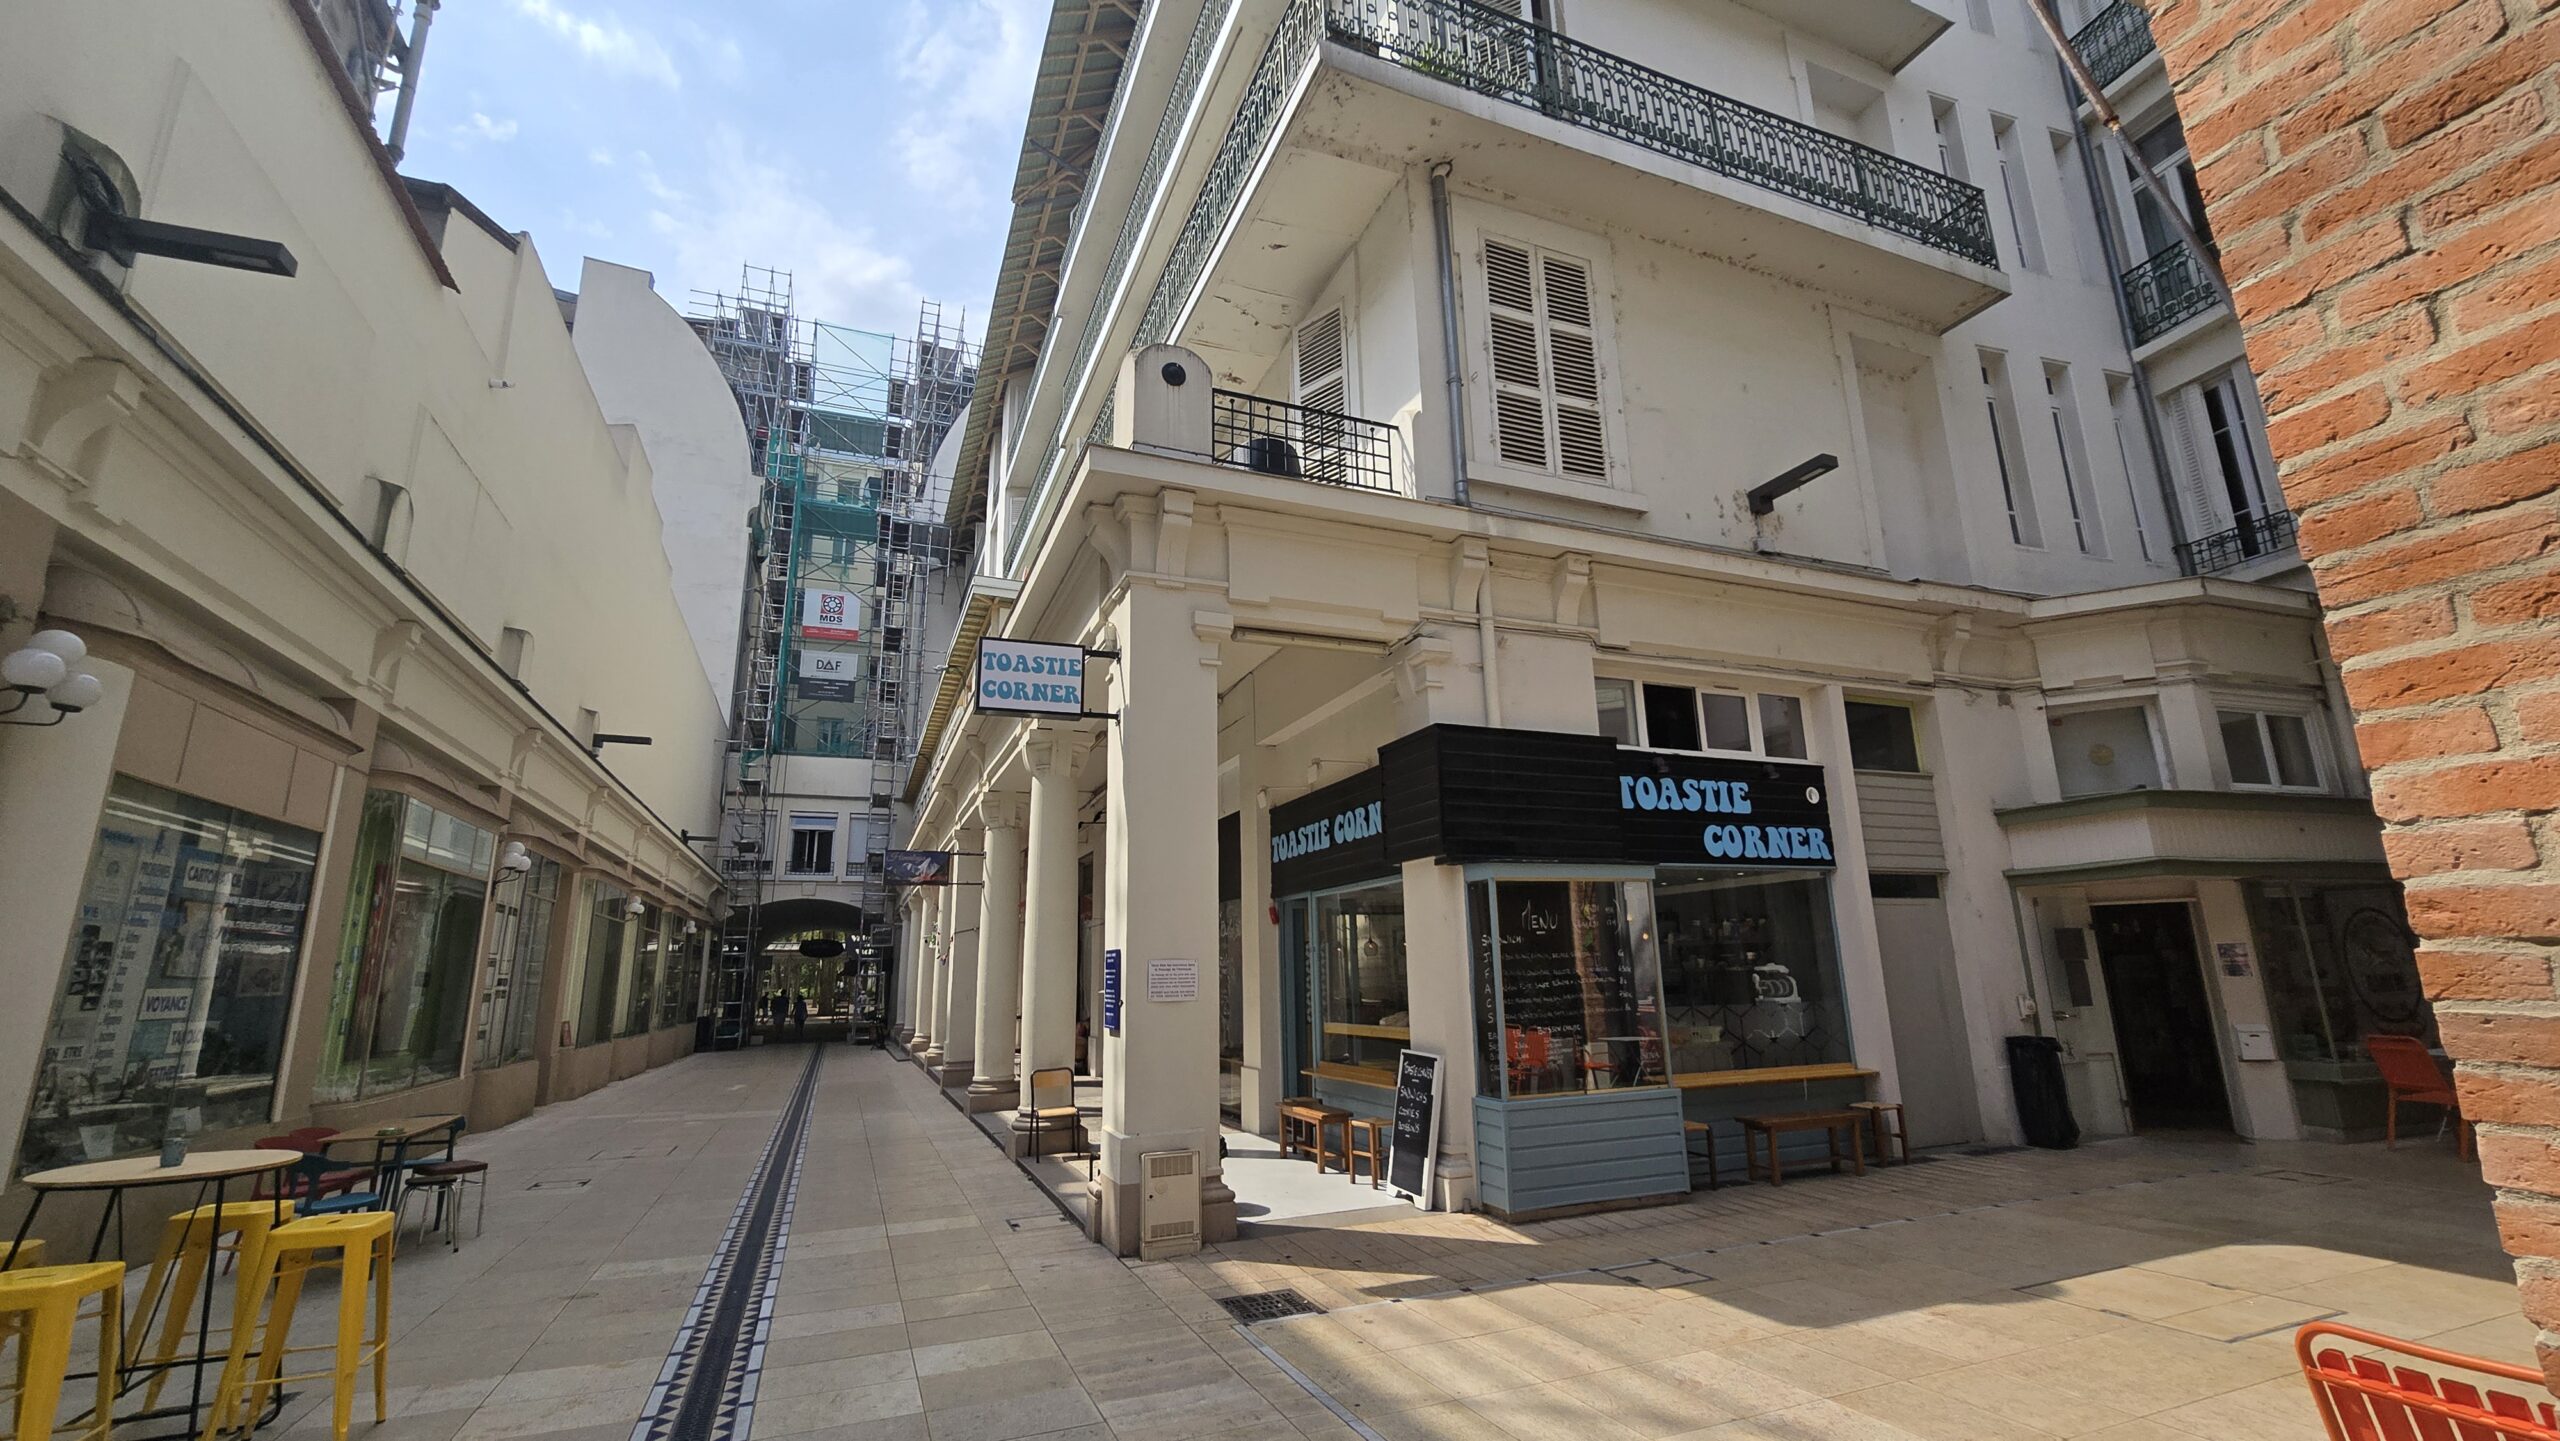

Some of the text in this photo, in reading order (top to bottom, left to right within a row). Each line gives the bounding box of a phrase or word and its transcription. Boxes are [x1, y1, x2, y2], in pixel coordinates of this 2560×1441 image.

[819, 614, 843, 624] MDS
[983, 652, 1081, 677] TOASTIE
[982, 680, 1080, 704] CORNER
[1620, 776, 1752, 814] TOASTIE
[1272, 800, 1382, 863] TOASTIE CORN
[1704, 824, 1832, 860] CORNER
[1521, 900, 1558, 931] MENU
[146, 995, 188, 1012] VOYANCE
